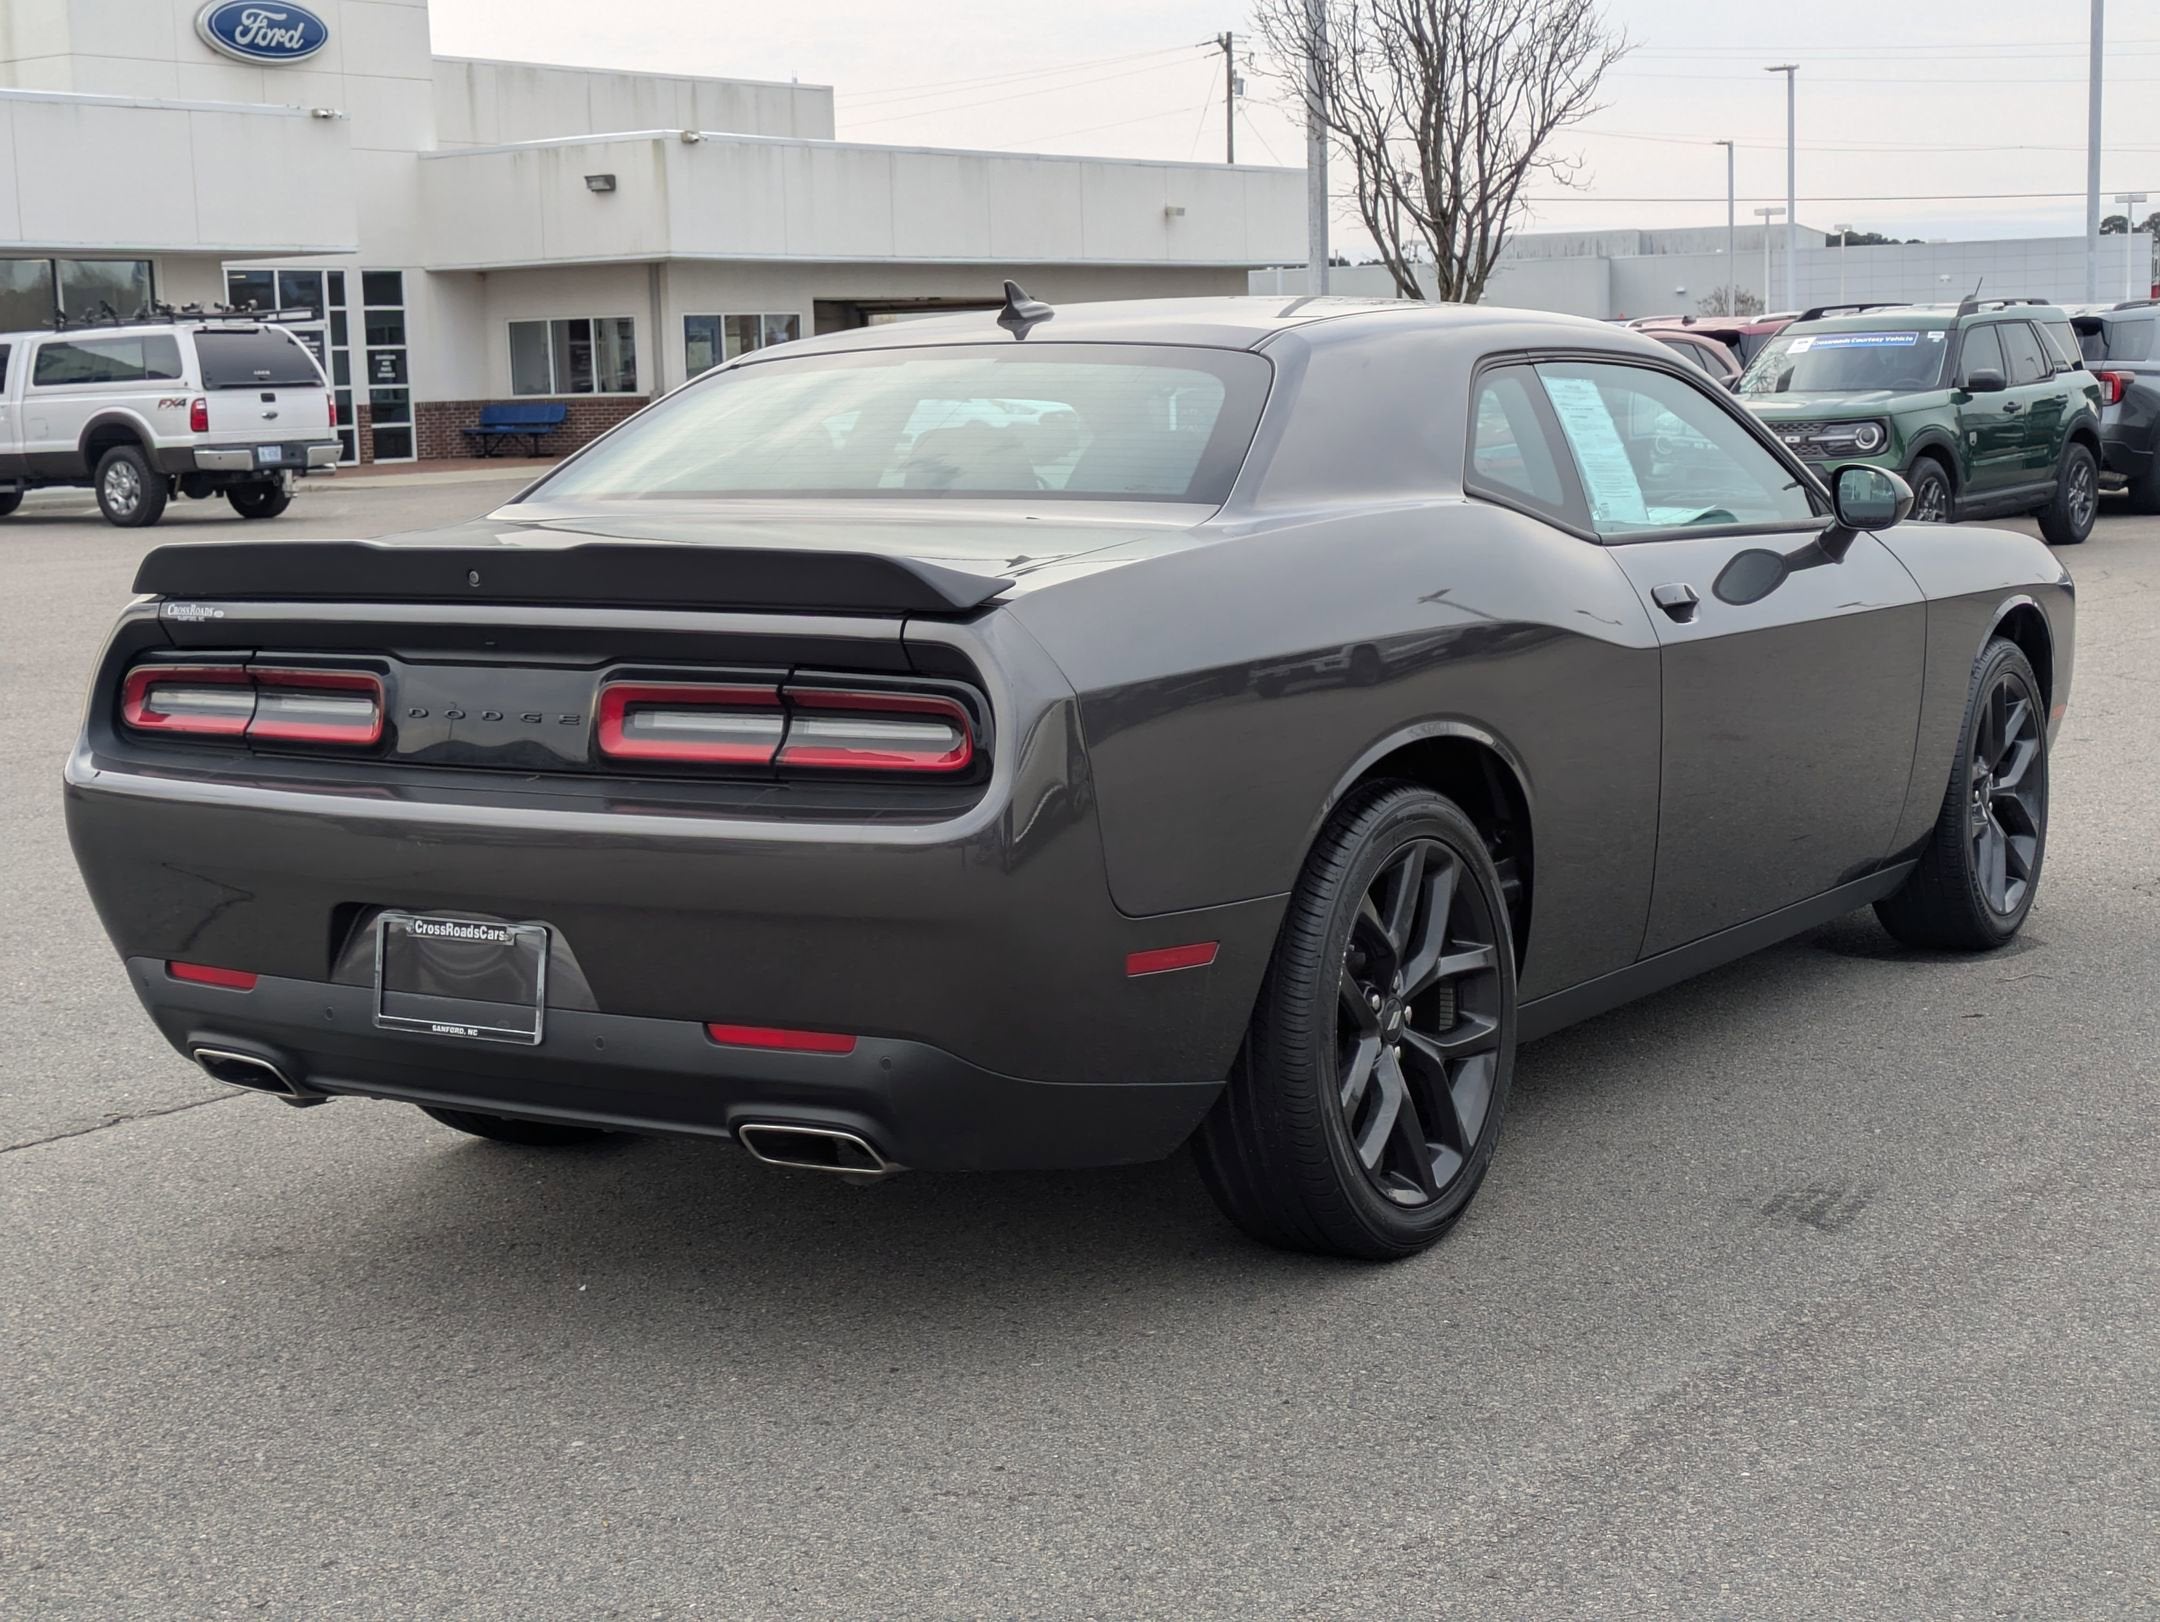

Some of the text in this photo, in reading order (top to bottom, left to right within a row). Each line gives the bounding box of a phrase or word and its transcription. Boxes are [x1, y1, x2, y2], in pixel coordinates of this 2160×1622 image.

[235, 9, 305, 49] Ford
[1851, 336, 1884, 345] Courtesy
[1885, 335, 1914, 343] Vehicle
[158, 398, 187, 409] FX4
[408, 707, 581, 726] DODGE
[415, 919, 506, 941] CrossRoadsCars
[432, 1024, 479, 1036] SANFORD, NC
